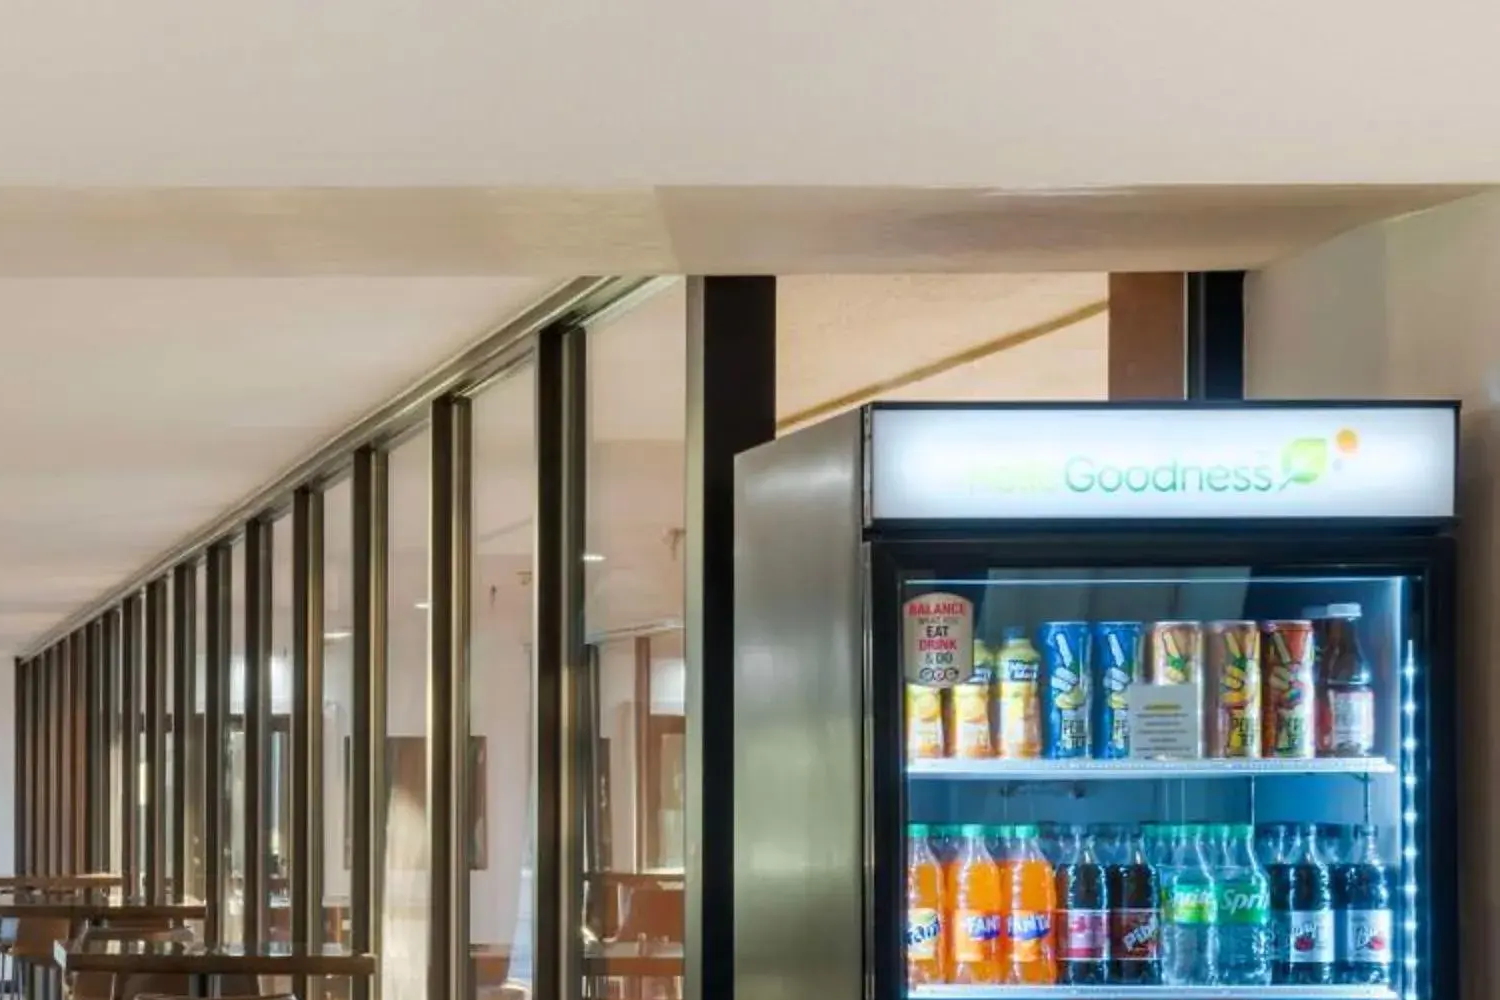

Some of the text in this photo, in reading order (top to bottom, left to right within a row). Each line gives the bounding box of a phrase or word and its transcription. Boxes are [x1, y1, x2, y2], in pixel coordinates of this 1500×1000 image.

[1064, 455, 1273, 493] Goodness
[908, 603, 965, 617] BALANCE
[926, 626, 949, 638] EAT
[918, 639, 957, 651] DRINK
